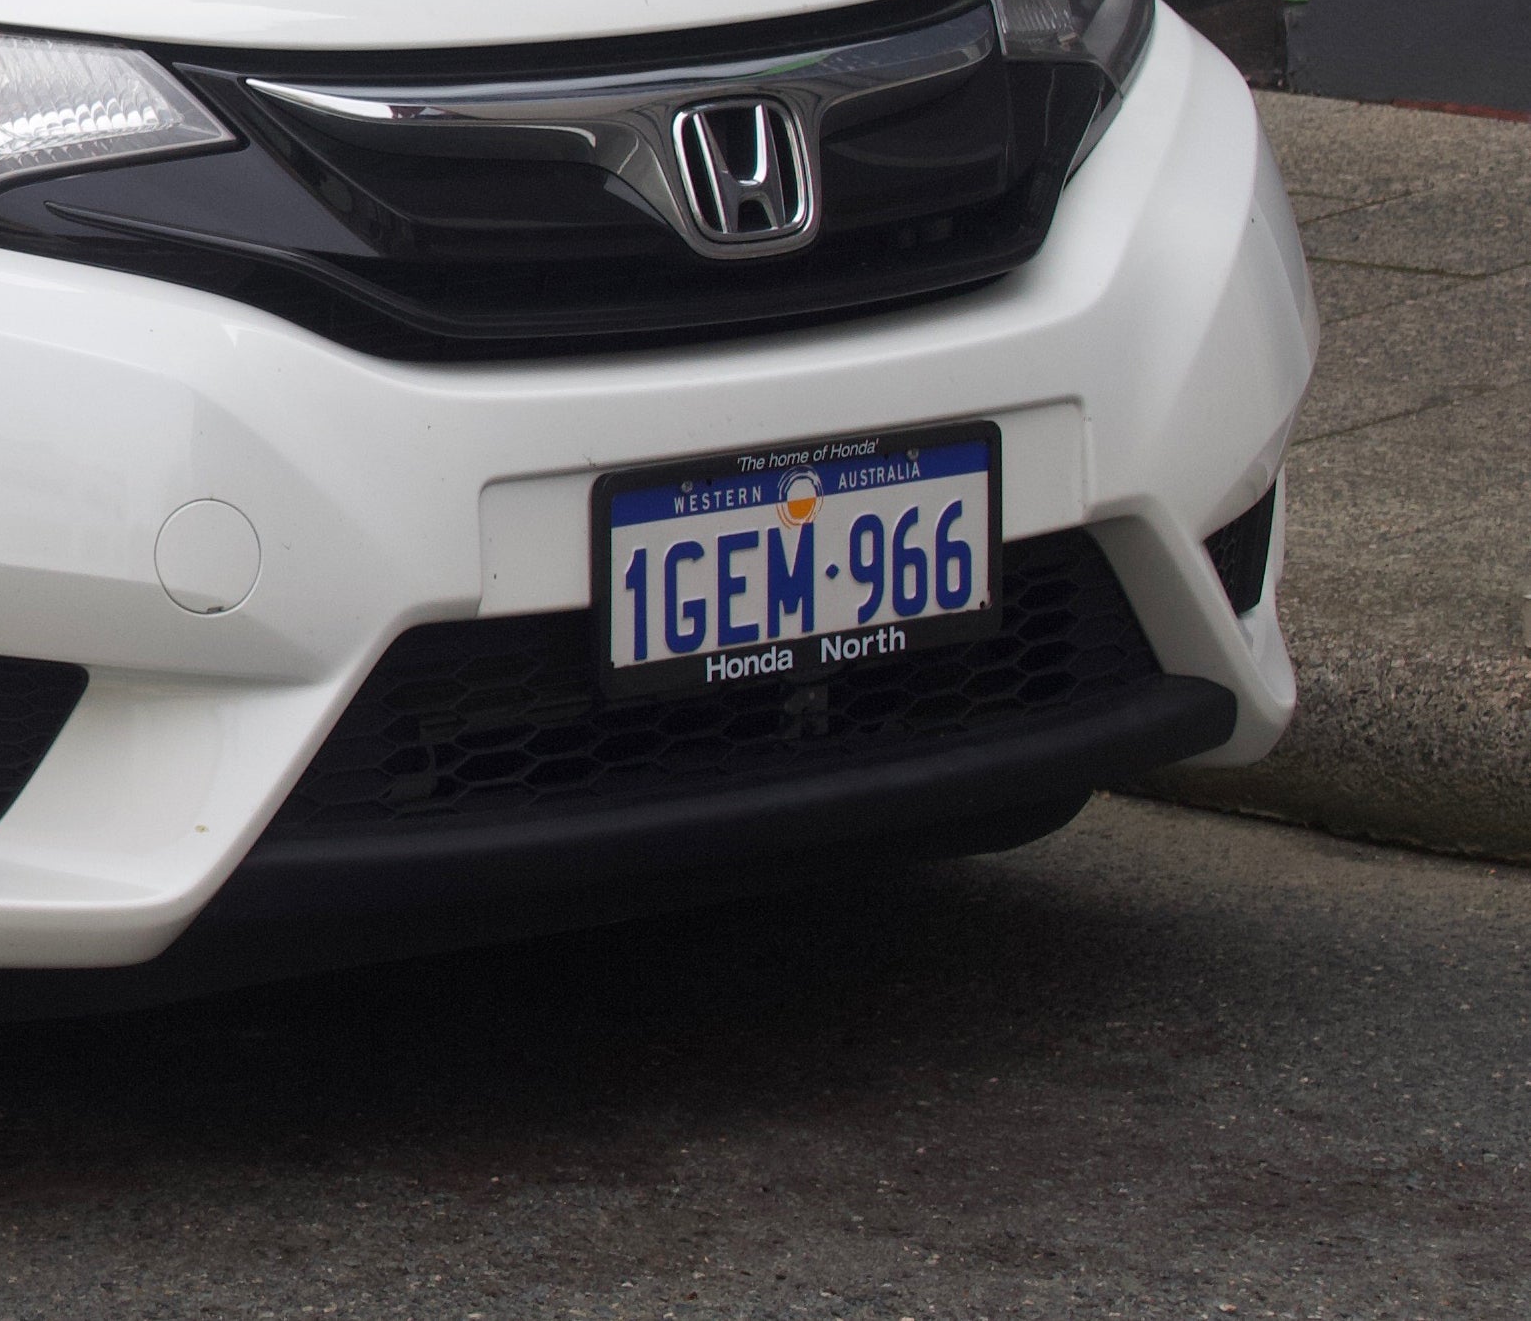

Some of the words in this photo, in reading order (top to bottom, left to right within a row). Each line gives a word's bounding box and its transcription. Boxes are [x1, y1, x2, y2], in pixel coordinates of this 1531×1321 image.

[767, 449, 810, 468] home
[812, 445, 829, 463] of
[673, 485, 763, 514] WESTERN
[838, 461, 921, 490] AUSTRALIA
[705, 646, 794, 683] Honda
[820, 627, 906, 663] North
